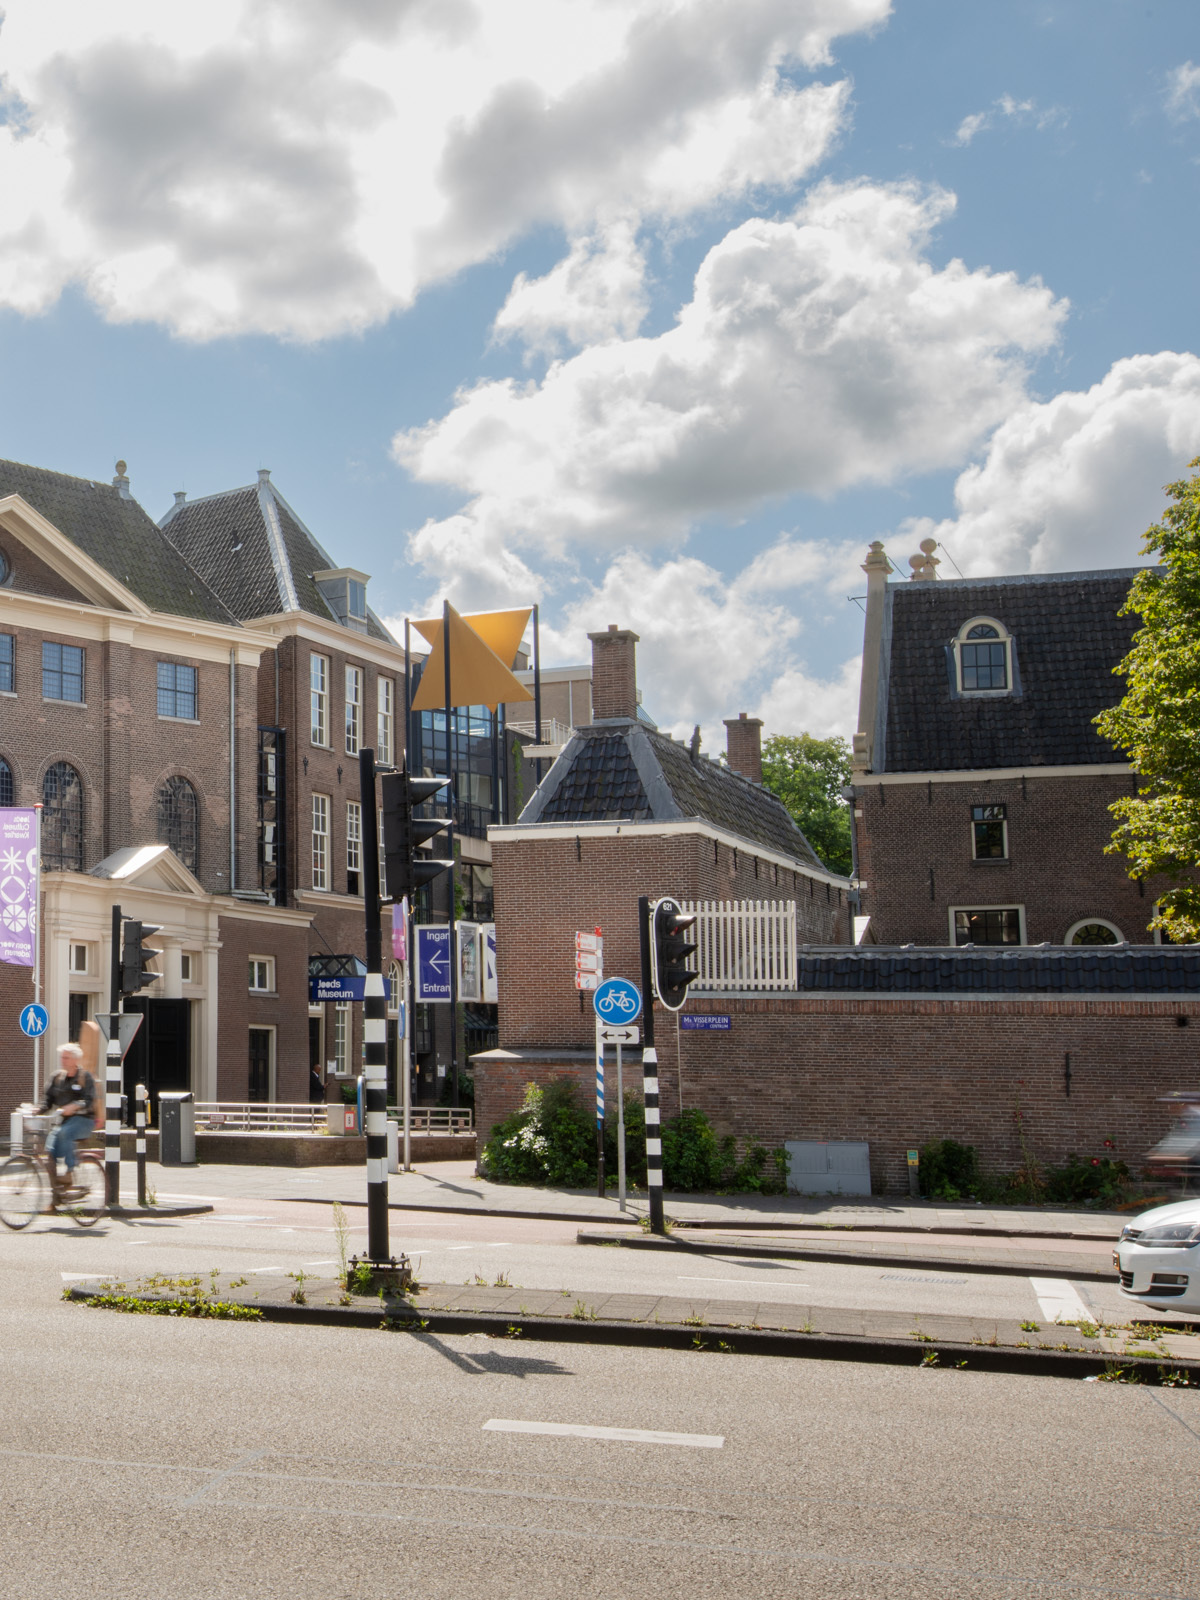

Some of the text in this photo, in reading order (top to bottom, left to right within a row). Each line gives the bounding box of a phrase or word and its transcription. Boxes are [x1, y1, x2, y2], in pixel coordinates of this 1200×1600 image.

[426, 931, 450, 942] Ingan
[317, 979, 341, 989] Joods
[423, 983, 450, 993] Entran
[317, 989, 354, 998] Museum
[693, 1016, 729, 1024] VISSERPLEIN
